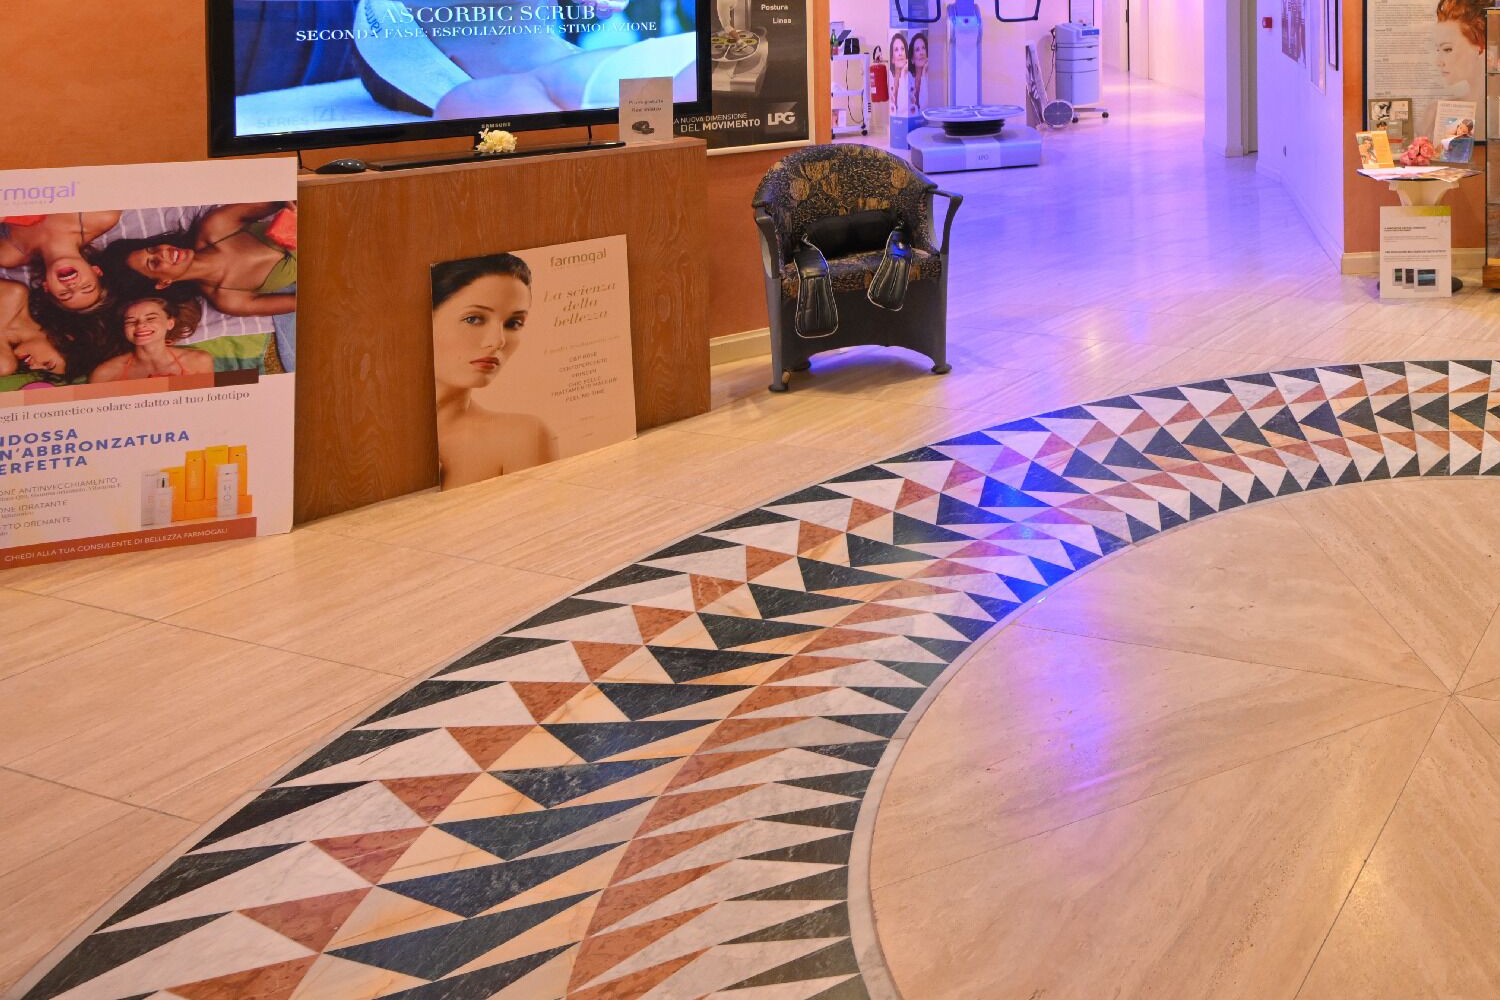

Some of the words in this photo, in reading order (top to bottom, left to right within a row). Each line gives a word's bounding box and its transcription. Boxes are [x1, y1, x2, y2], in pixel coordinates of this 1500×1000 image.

[381, 6, 513, 24] ASCORBIC
[520, 5, 596, 21] SCRUB
[760, 3, 789, 11] Postura
[296, 27, 380, 42] SECONDA
[385, 26, 428, 39] FASE:
[432, 24, 543, 38] ESFOLIAZIONE
[545, 24, 554, 33] E
[558, 21, 657, 34] STIMOLAZIONE
[481, 121, 511, 129] SAMSUNG
[680, 115, 704, 124] NUOVA
[705, 112, 748, 122] DIMENSIONE
[680, 123, 700, 133] DEL
[702, 118, 761, 131] MOVIMENTO
[767, 111, 796, 126] LPG
[550, 247, 607, 268] farmogal
[544, 289, 562, 303] La
[566, 282, 616, 298] scienza
[563, 297, 598, 312] della
[554, 309, 608, 328] bellezza
[22, 411, 32, 420] il
[33, 406, 94, 419] cosmetico
[96, 401, 132, 413] solare
[134, 398, 170, 409] adatto
[172, 396, 182, 405] al
[185, 395, 204, 404] tuo
[206, 390, 251, 404] fototipo
[18, 499, 68, 512] IDRATANTE
[5, 552, 35, 562] CHIEDI
[36, 550, 57, 559] ALLA
[58, 546, 76, 555] TUA
[77, 540, 132, 552] CONSULENTE
[144, 533, 183, 545] BELLEZZA
